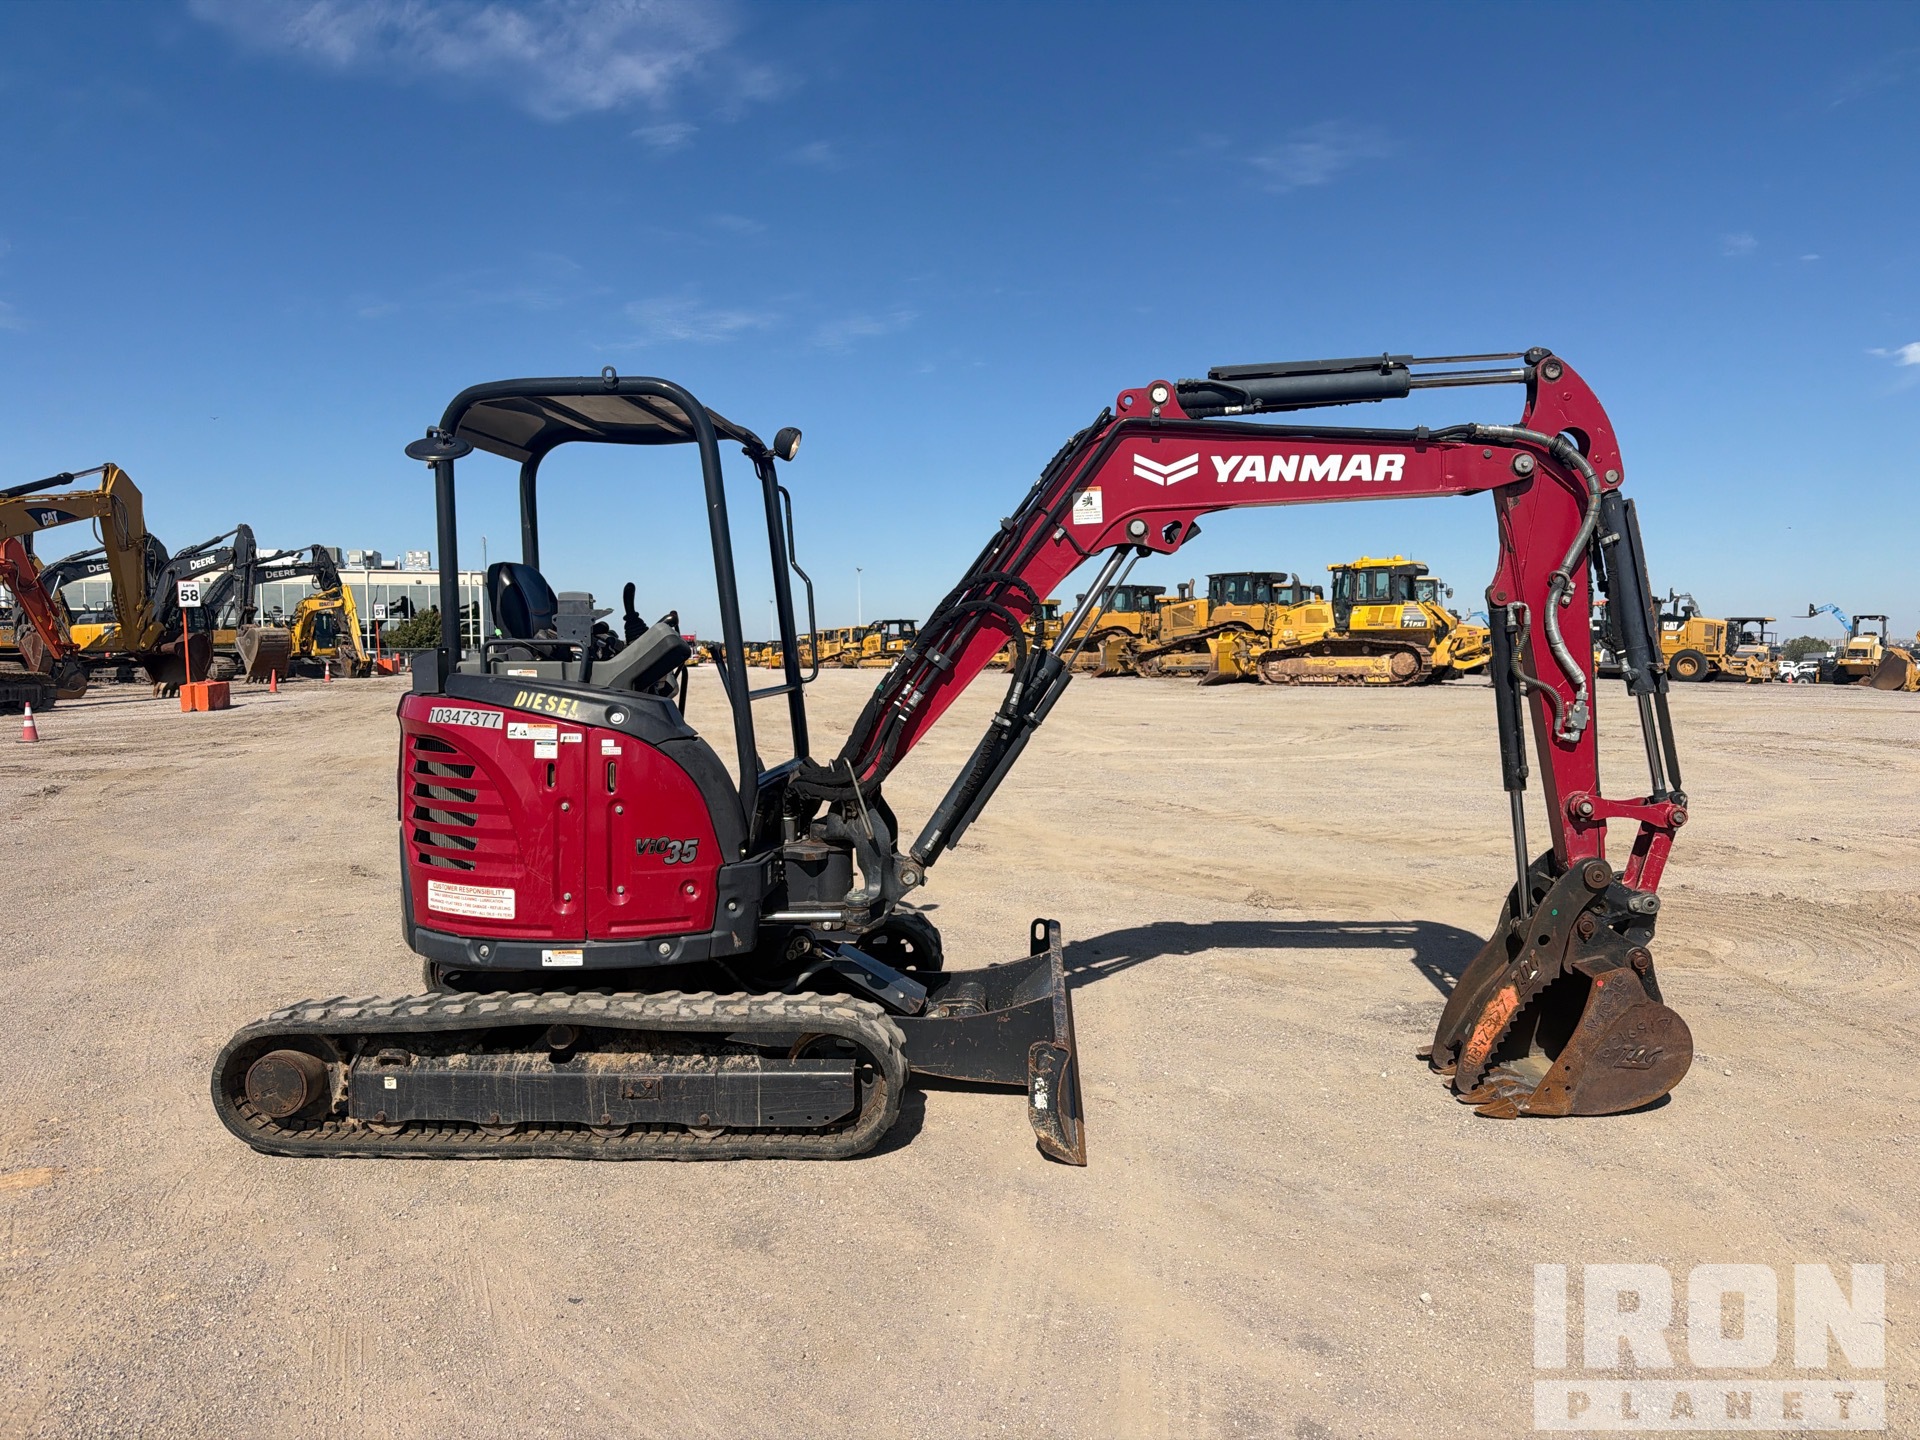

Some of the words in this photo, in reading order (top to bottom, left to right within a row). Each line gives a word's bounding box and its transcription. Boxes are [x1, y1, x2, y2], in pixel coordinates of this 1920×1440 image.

[1210, 453, 1406, 483] YANMAR
[41, 510, 59, 526] CAT
[87, 562, 109, 573] DEE
[189, 554, 216, 570] DEERE
[265, 568, 297, 579] DEERE
[180, 589, 199, 602] 58
[375, 608, 385, 616] 57
[1663, 621, 1679, 631] CAT
[513, 690, 580, 718] DIESEL
[430, 709, 501, 728] 10347377
[433, 882, 458, 892] CUSTOMER
[459, 886, 506, 896] RESPONSIBILITY
